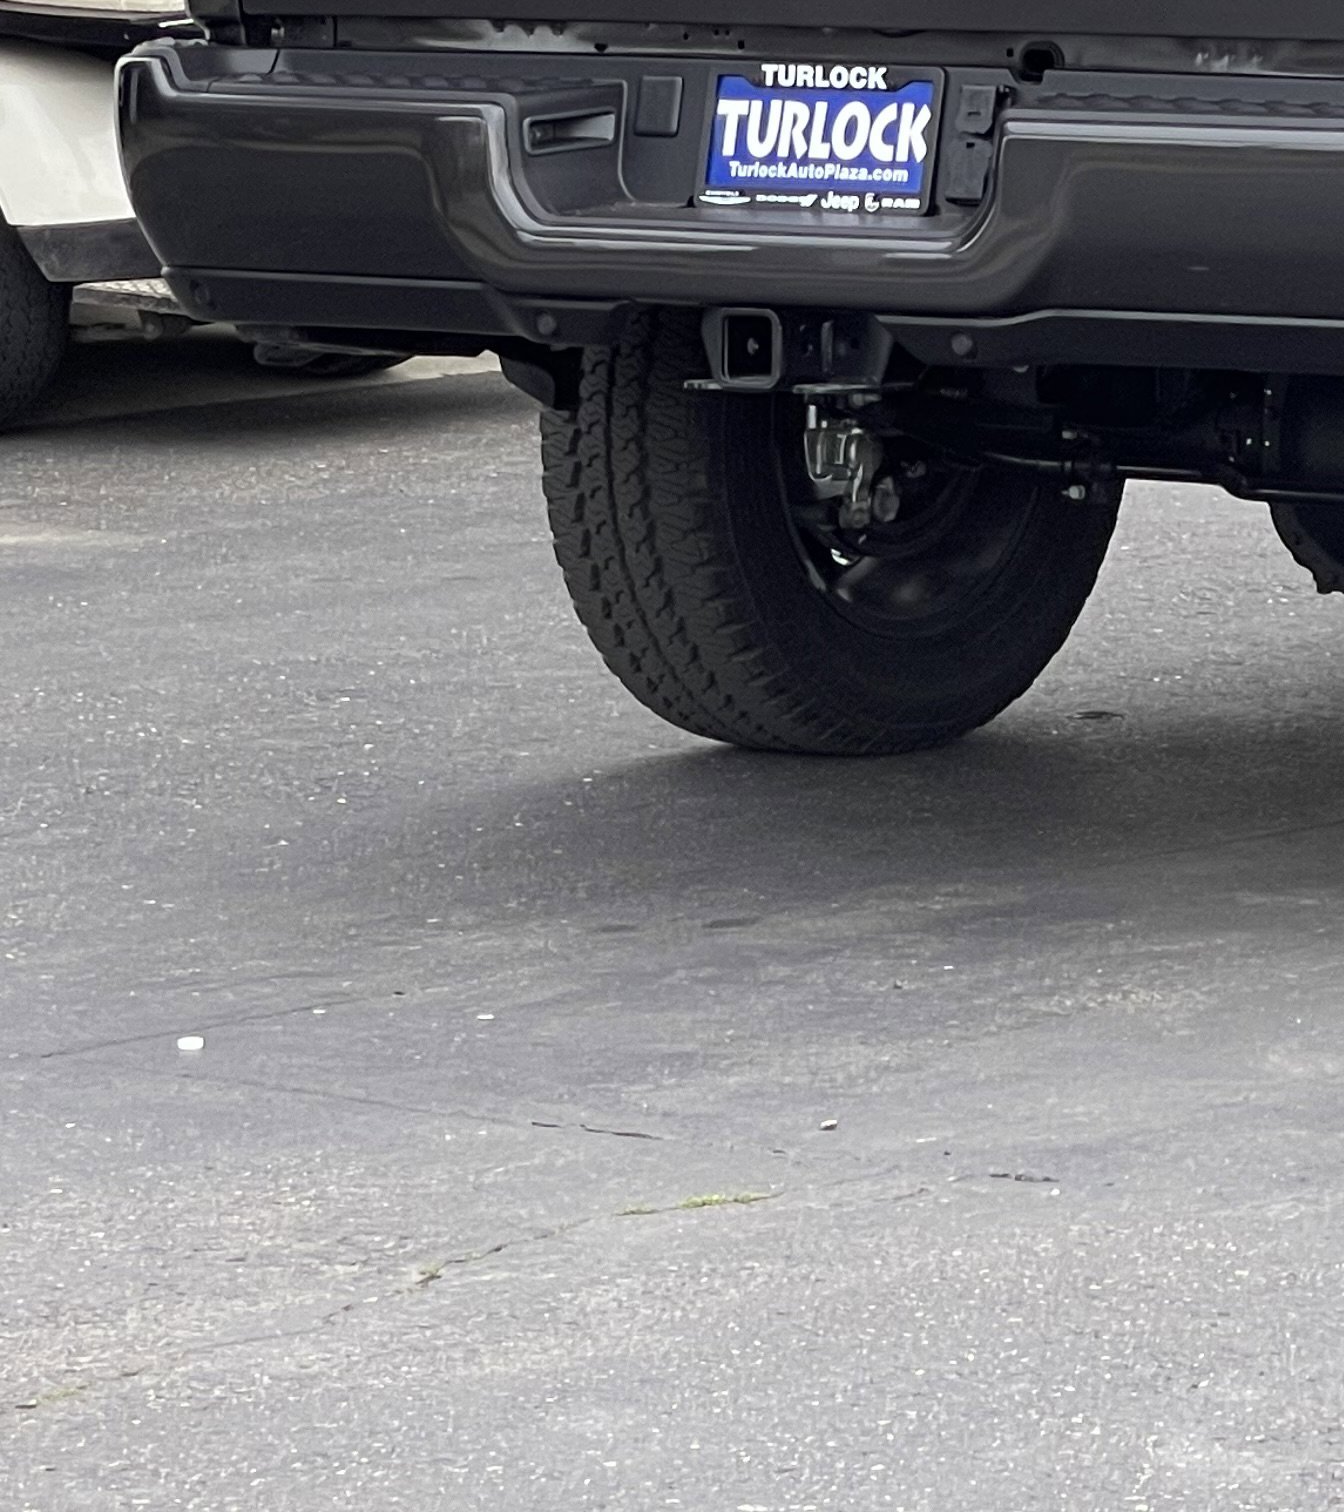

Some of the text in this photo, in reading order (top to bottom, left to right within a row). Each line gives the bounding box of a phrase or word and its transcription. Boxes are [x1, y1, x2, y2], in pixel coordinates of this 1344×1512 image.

[761, 64, 887, 90] TURLOCK
[717, 99, 932, 163] TURLOCK
[729, 160, 908, 182] TurlockAutoPlaza.com
[821, 191, 860, 212] Jeep
